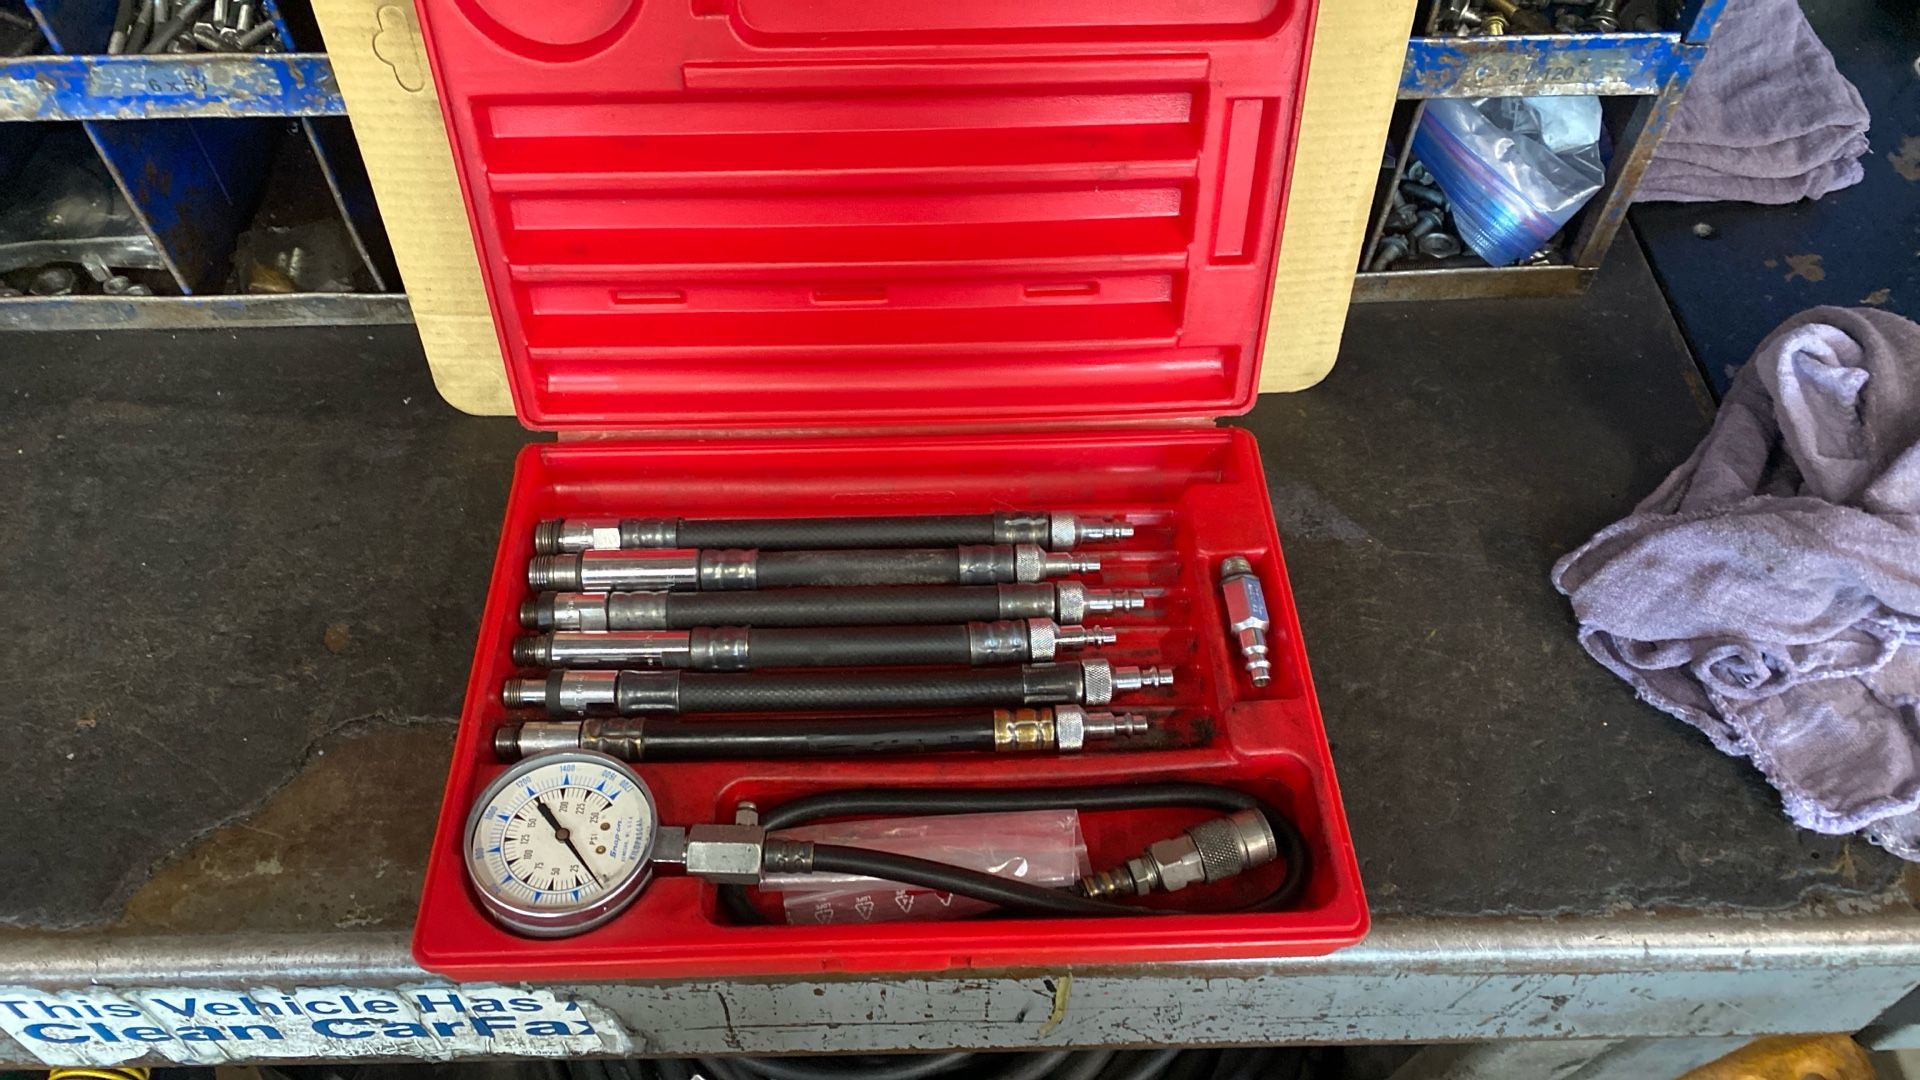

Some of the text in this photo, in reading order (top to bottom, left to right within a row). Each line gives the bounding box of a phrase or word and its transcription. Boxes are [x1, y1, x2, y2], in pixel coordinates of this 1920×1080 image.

[1543, 67, 1575, 80] 120
[148, 79, 162, 92] 6
[560, 764, 576, 773] 1400
[515, 775, 532, 788] 1200
[559, 801, 569, 813] 200
[575, 803, 585, 815] 225
[527, 818, 537, 828] 150
[589, 811, 600, 824] 250
[520, 834, 530, 845] 125
[589, 833, 598, 845] PSI
[550, 867, 560, 876] 50
[570, 864, 580, 873] 25
[0, 1000, 141, 1019] This
[150, 995, 400, 1019] Vehicle
[415, 994, 543, 1013] Has
[23, 1022, 285, 1044] Clean
